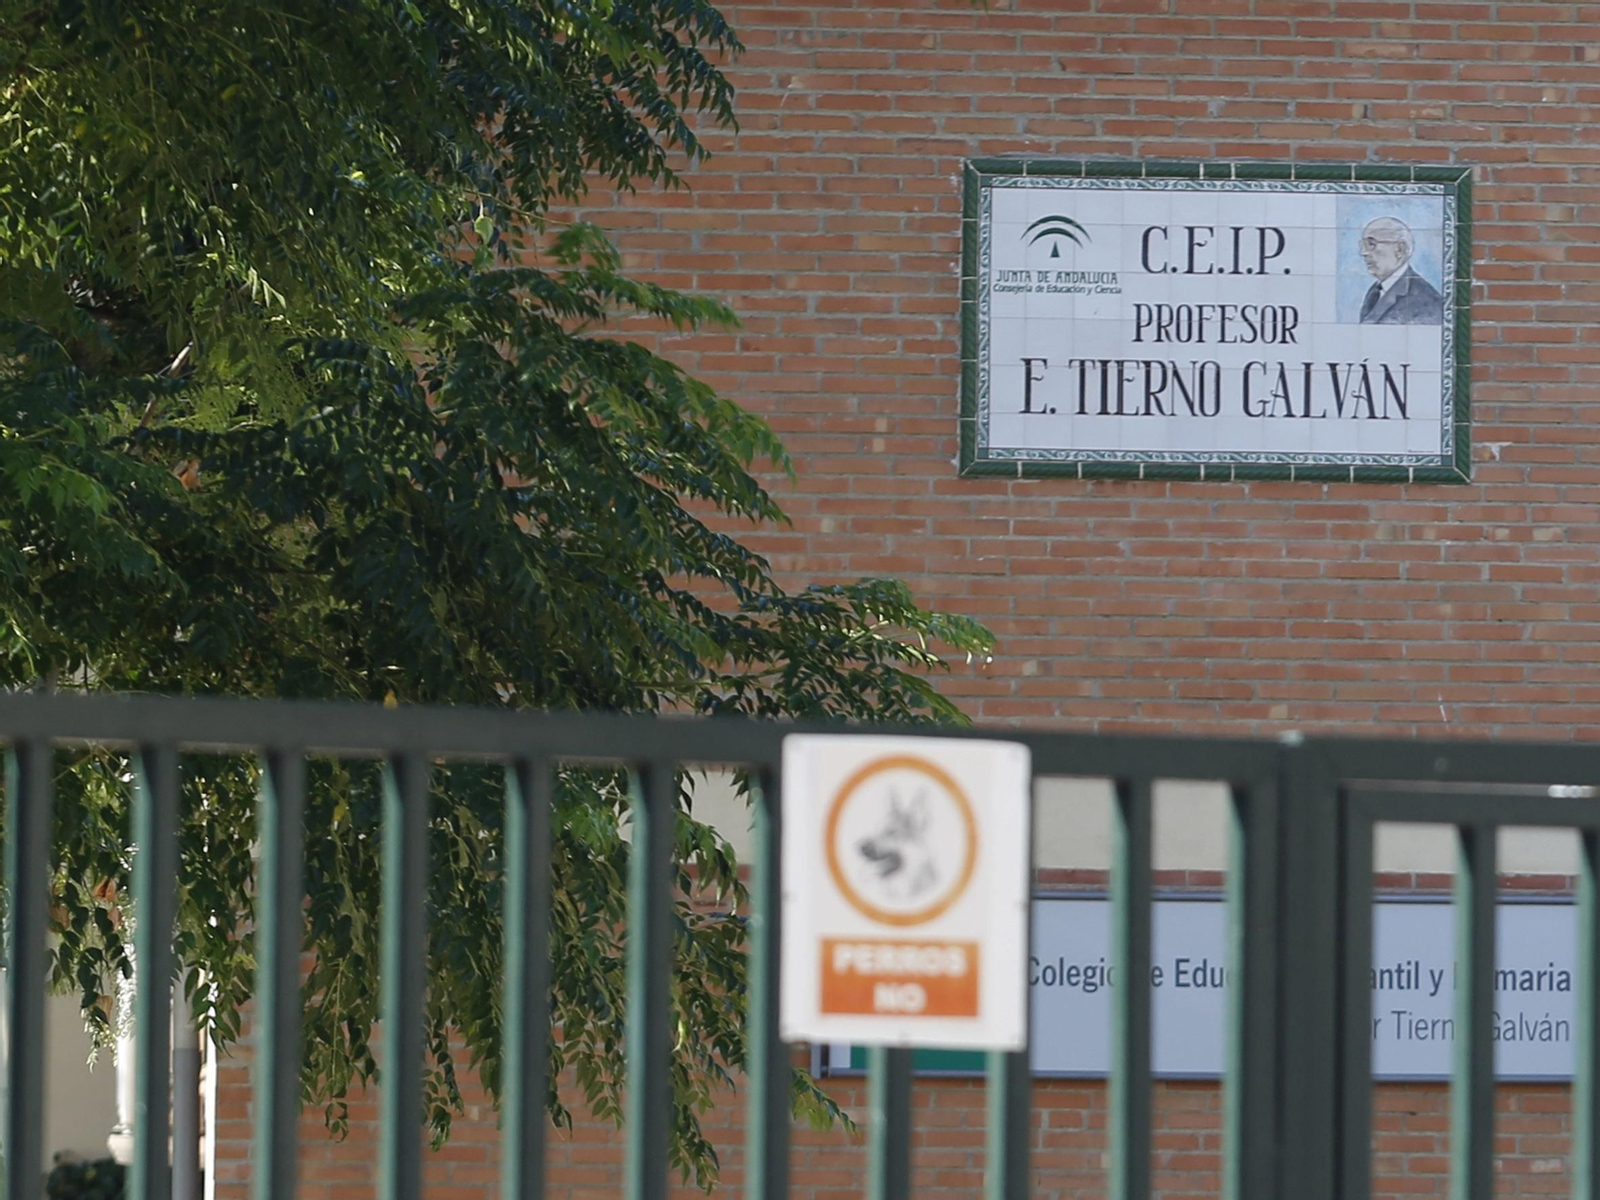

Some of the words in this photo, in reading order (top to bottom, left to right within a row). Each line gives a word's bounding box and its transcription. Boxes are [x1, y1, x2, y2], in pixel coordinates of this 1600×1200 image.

[1141, 226, 1291, 275] C.E.I.P.
[996, 270, 1031, 282] JUNTA
[1037, 270, 1051, 283] DE
[1132, 303, 1298, 344] PROFESOR
[1018, 357, 1056, 414] E.
[1068, 358, 1221, 417] TIERNO
[1242, 358, 1411, 420] GALVÁN
[832, 943, 968, 977] PERROS
[1429, 968, 1444, 997] y
[1453, 961, 1571, 991] maria
[873, 981, 928, 1013] NO
[1391, 1010, 1455, 1040] Tiern
